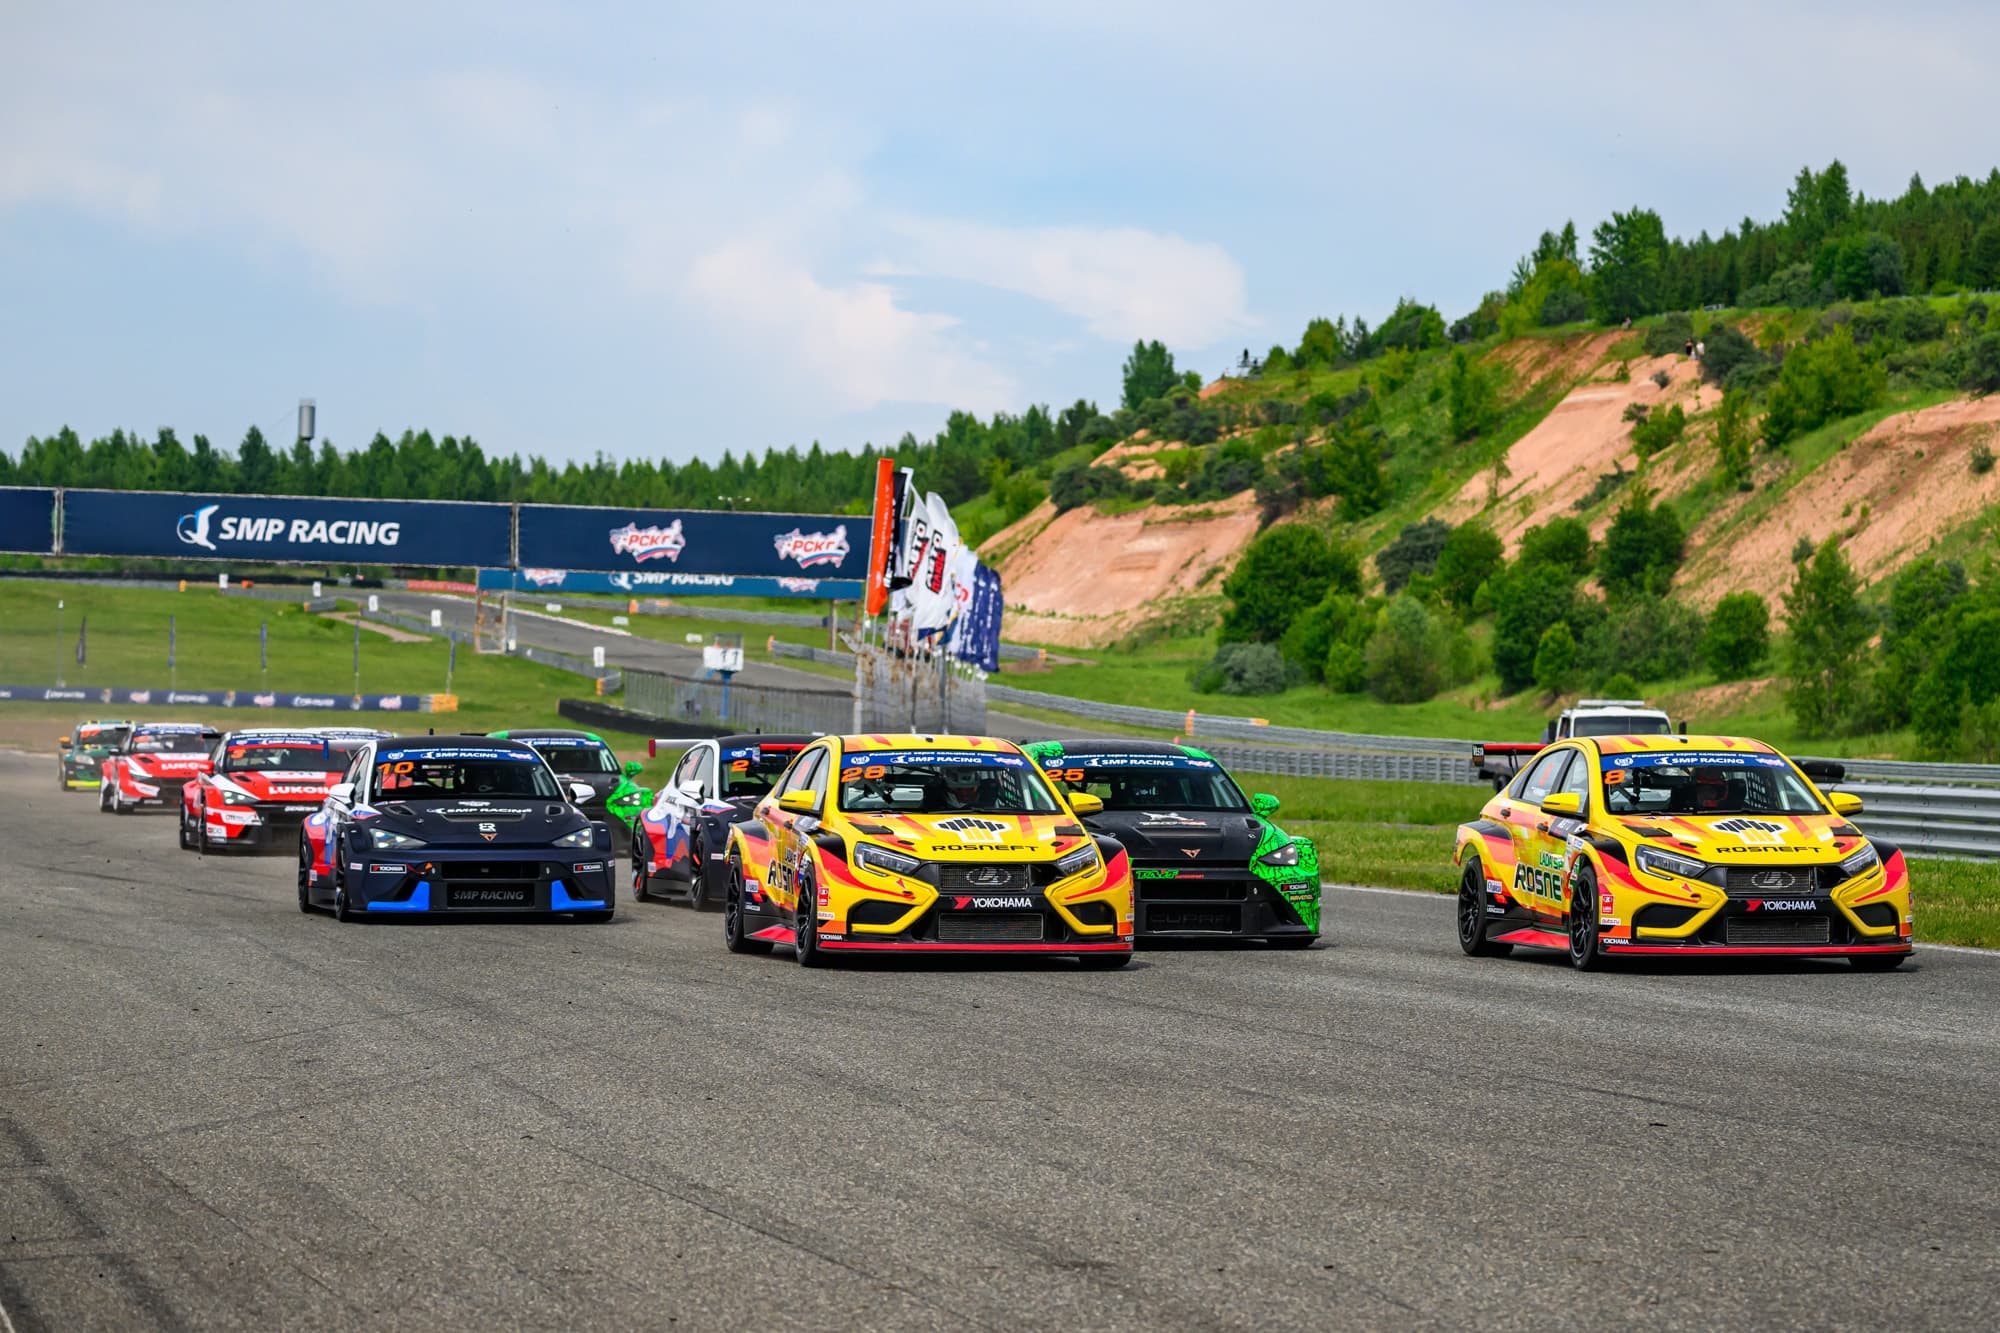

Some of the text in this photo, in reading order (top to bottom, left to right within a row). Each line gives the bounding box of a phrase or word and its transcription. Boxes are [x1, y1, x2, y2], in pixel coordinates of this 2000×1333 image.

[219, 517, 400, 545] SMP RACING
[377, 761, 415, 775] 10
[731, 760, 750, 772] 2
[841, 765, 887, 783] 28
[1045, 768, 1085, 782] 25
[1604, 769, 1626, 785] 8
[932, 844, 1039, 852] ROSNEFT
[1514, 863, 1562, 902] ROSNE
[453, 890, 524, 900] SMP RACING
[973, 898, 1032, 908] YOKOHAMA
[1763, 900, 1816, 910] YOKOHAMA
